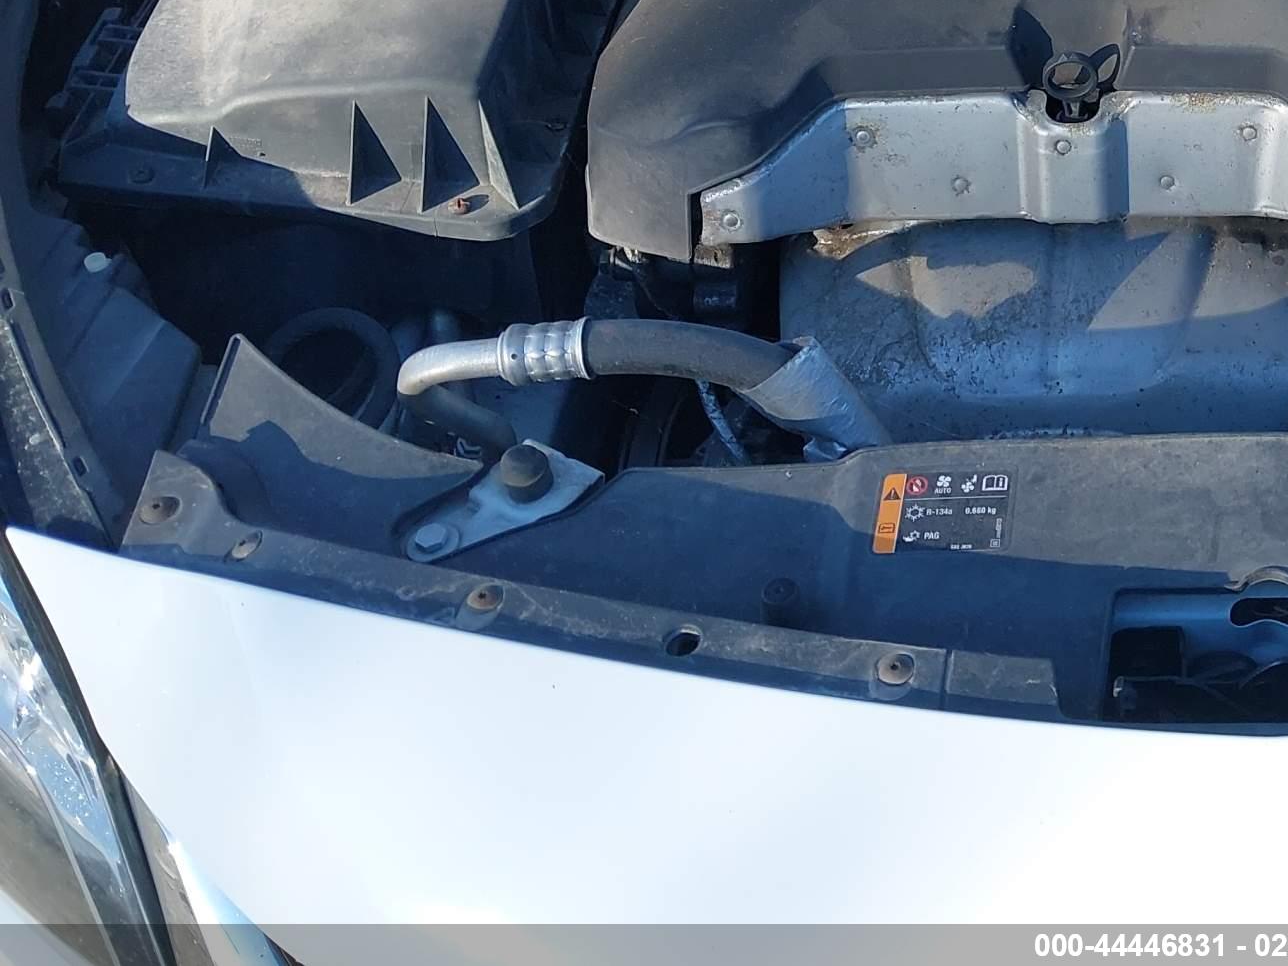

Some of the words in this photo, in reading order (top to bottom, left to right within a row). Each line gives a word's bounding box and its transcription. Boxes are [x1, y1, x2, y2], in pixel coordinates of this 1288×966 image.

[926, 508, 953, 516] R-134a
[987, 506, 997, 516] kg
[923, 531, 940, 540] PAG
